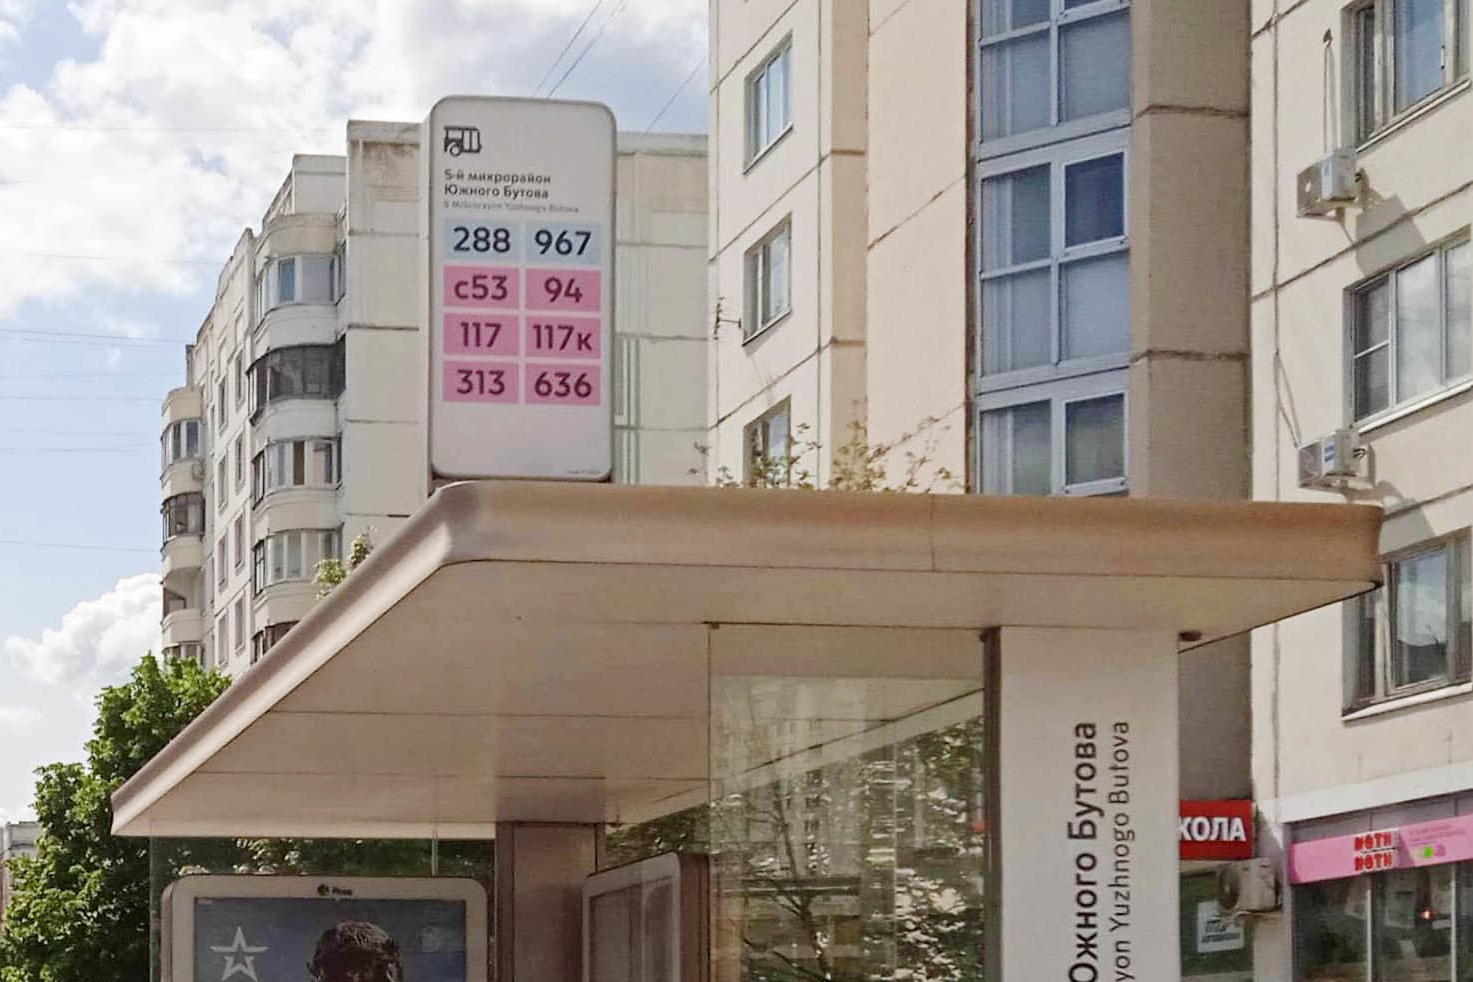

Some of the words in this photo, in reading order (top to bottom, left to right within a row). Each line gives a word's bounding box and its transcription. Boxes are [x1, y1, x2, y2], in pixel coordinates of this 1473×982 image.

[444, 168, 465, 181] 5-й
[468, 172, 551, 185] микрорайон
[444, 183, 500, 197] Южного
[503, 185, 549, 200] Бутова
[453, 226, 511, 253] 288
[535, 229, 592, 256] 967
[454, 274, 508, 301] с53
[544, 276, 583, 303] 94
[460, 321, 502, 348] 117
[456, 368, 506, 396] 313
[534, 371, 593, 398] 636
[1108, 721, 1129, 804] Butova
[1067, 722, 1105, 840] Бутова
[1107, 813, 1135, 933] Yuzhnogo
